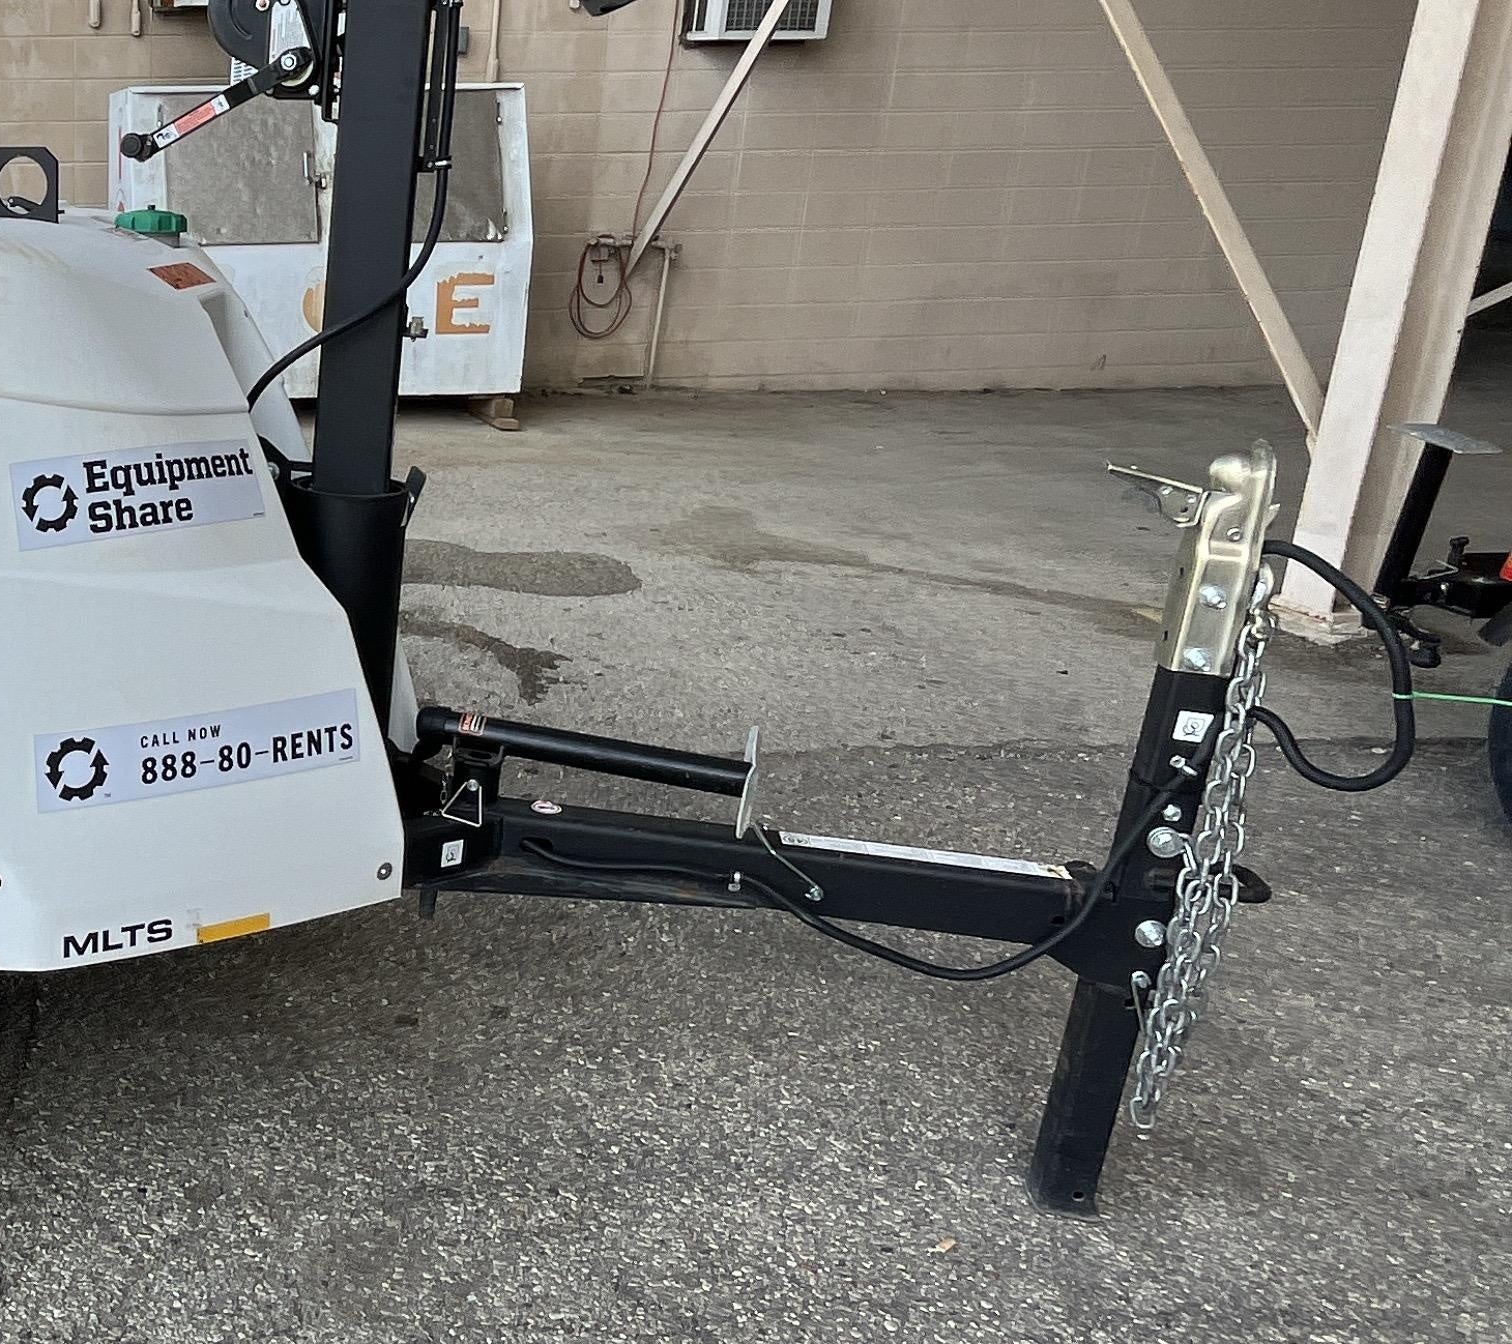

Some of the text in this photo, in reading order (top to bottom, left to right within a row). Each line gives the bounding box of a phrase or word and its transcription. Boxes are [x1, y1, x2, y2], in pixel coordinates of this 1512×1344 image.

[82, 448, 254, 497] Equipment
[88, 497, 194, 534] Share
[140, 724, 222, 749] CALL NOW
[141, 722, 354, 785] 888-80-RENTS
[62, 918, 173, 958] MLTS
